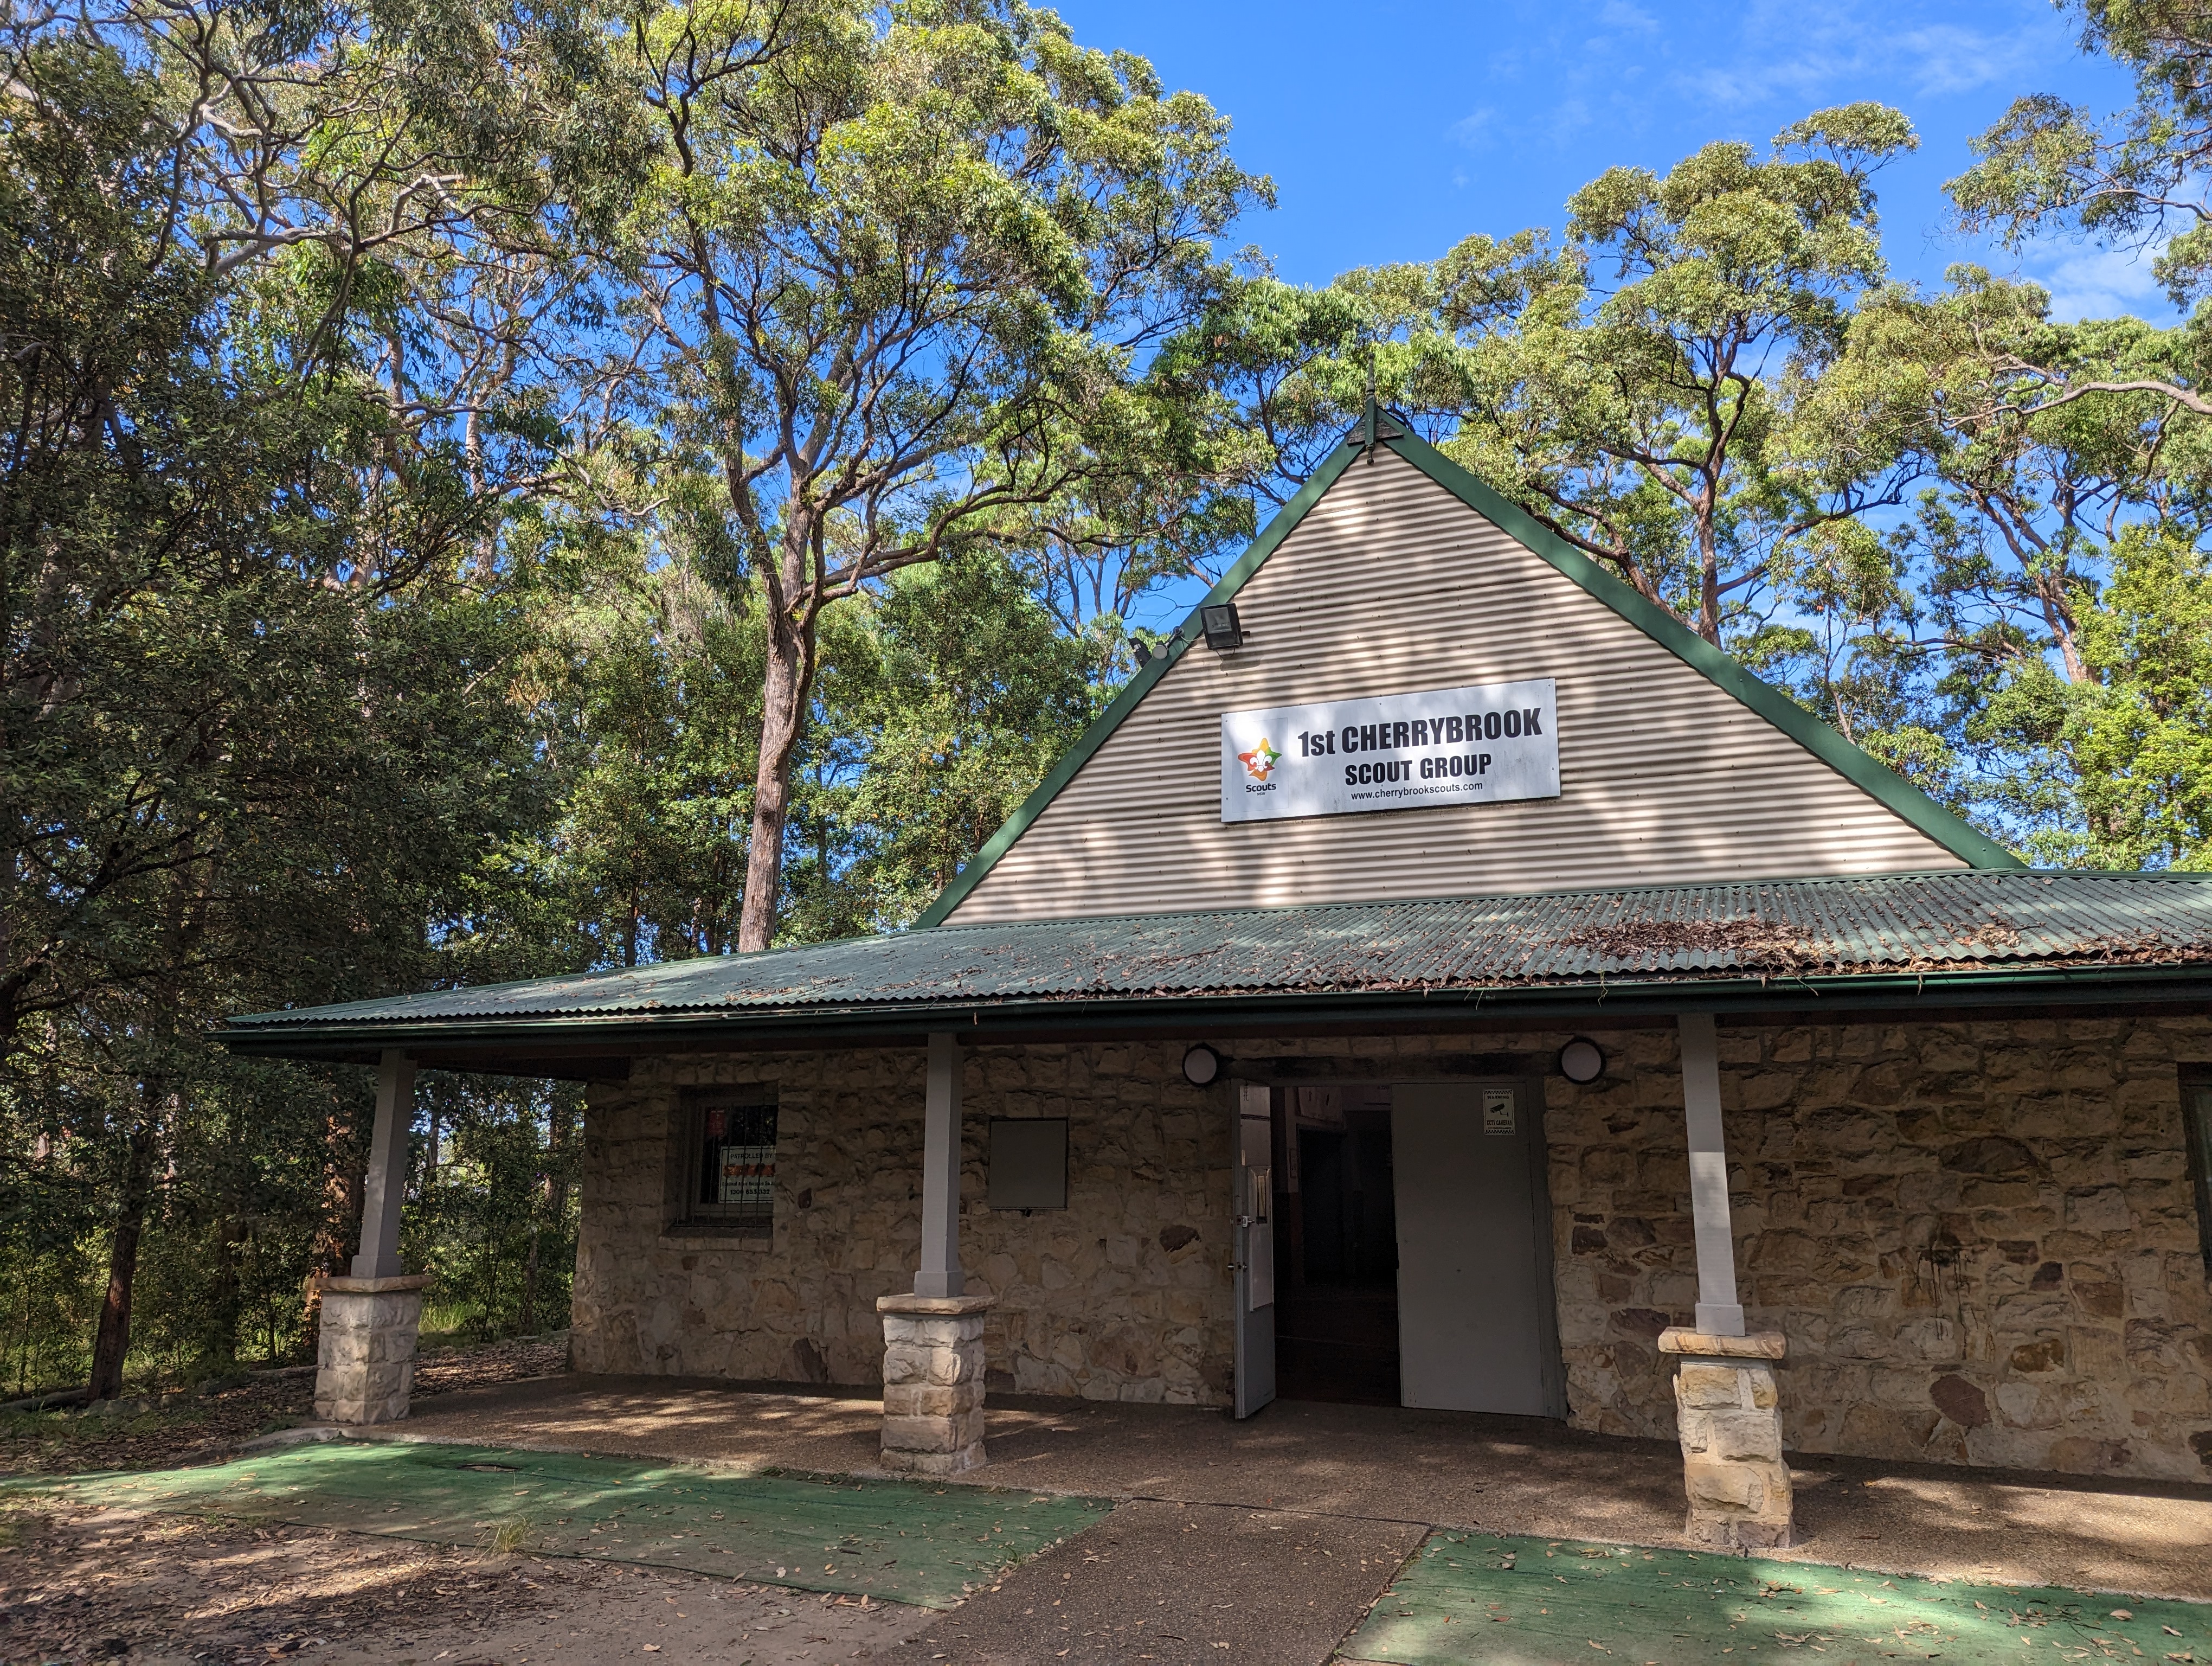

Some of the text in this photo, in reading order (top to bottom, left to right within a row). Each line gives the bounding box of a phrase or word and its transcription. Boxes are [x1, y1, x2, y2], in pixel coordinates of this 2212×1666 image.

[1298, 707, 1543, 757] 1st CHERRYBROOK
[1345, 753, 1491, 786] SCOUT GROUP
[1245, 783, 1277, 793] Scouts
[1351, 783, 1483, 800] www.cherrybrookscouts.com
